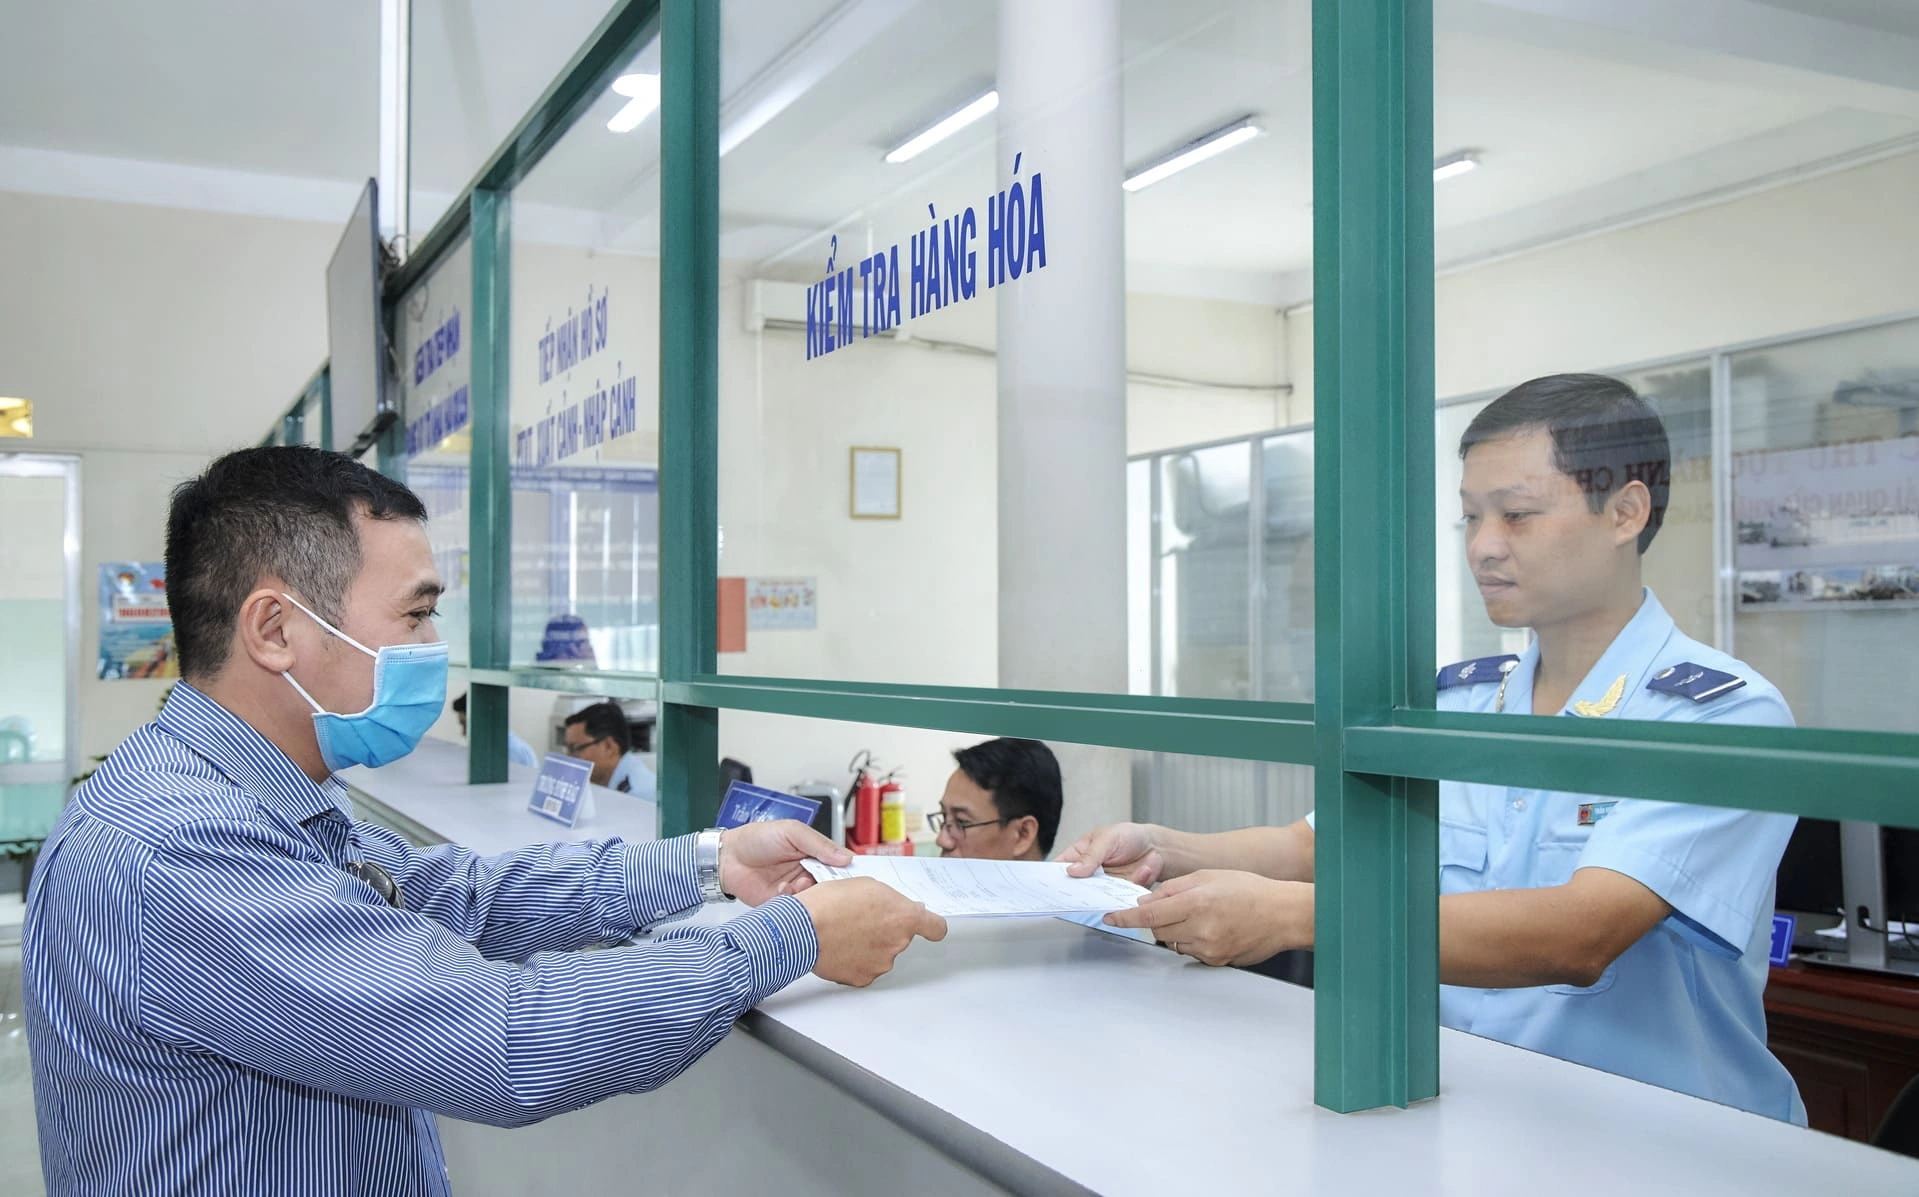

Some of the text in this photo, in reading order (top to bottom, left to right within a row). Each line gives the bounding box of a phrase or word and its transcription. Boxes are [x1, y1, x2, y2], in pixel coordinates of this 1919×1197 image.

[806, 152, 1047, 361] KIỂM TRA HÀNG HÓA
[609, 360, 636, 440] CẢNH
